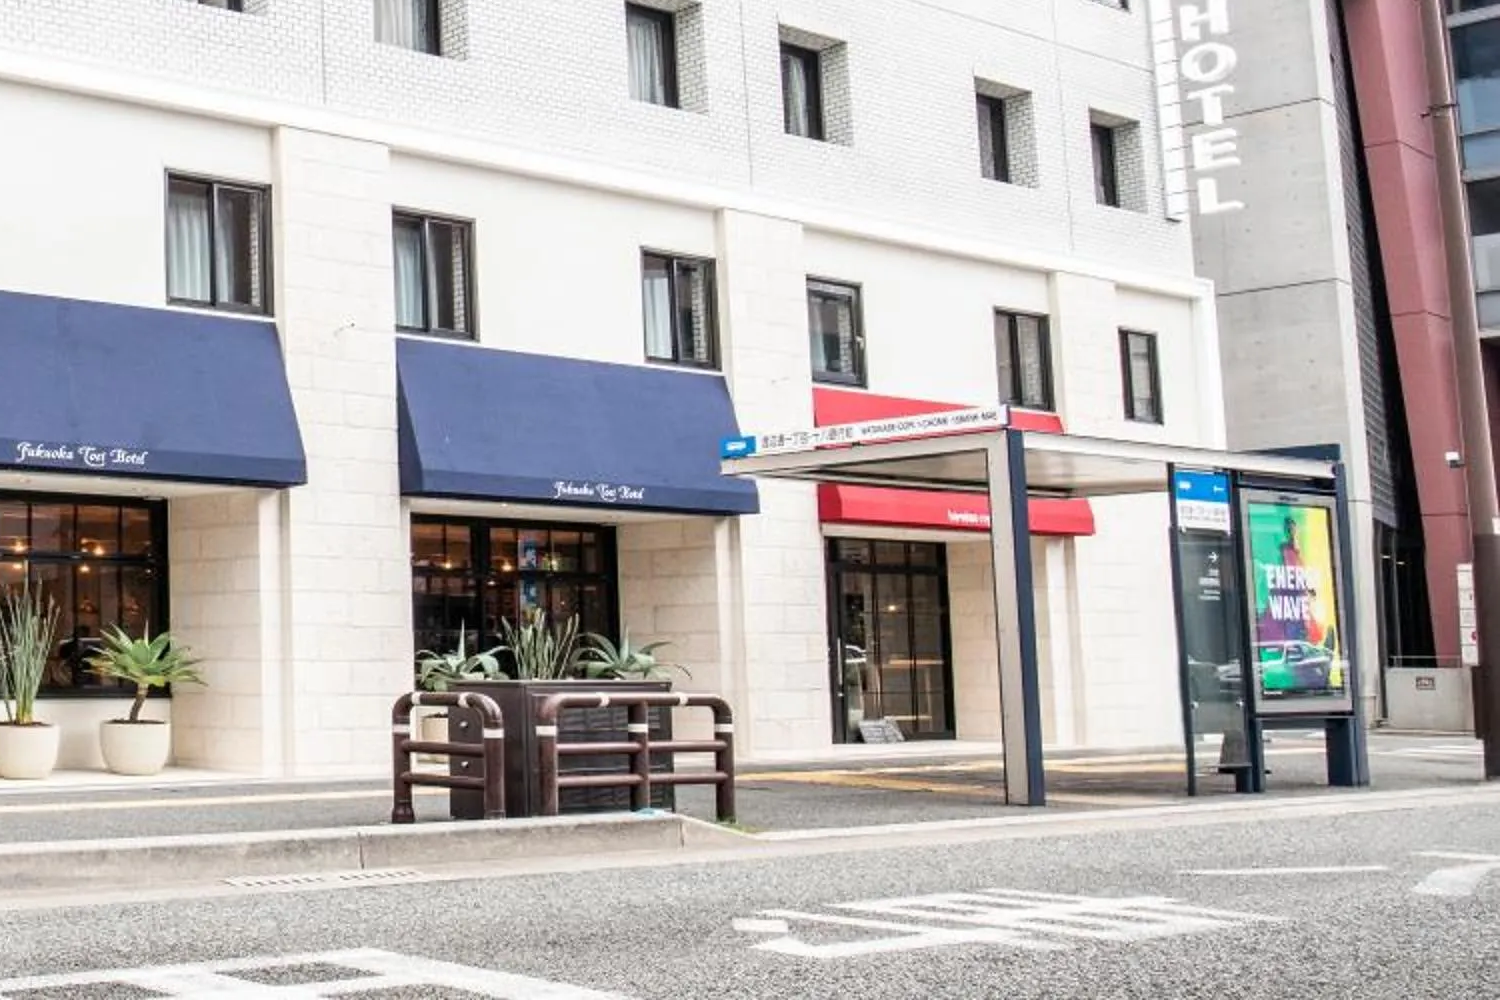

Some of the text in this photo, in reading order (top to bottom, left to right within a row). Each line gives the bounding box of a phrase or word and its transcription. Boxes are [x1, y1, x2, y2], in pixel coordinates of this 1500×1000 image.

[15, 441, 149, 468] Fukuoka Toei Hotel
